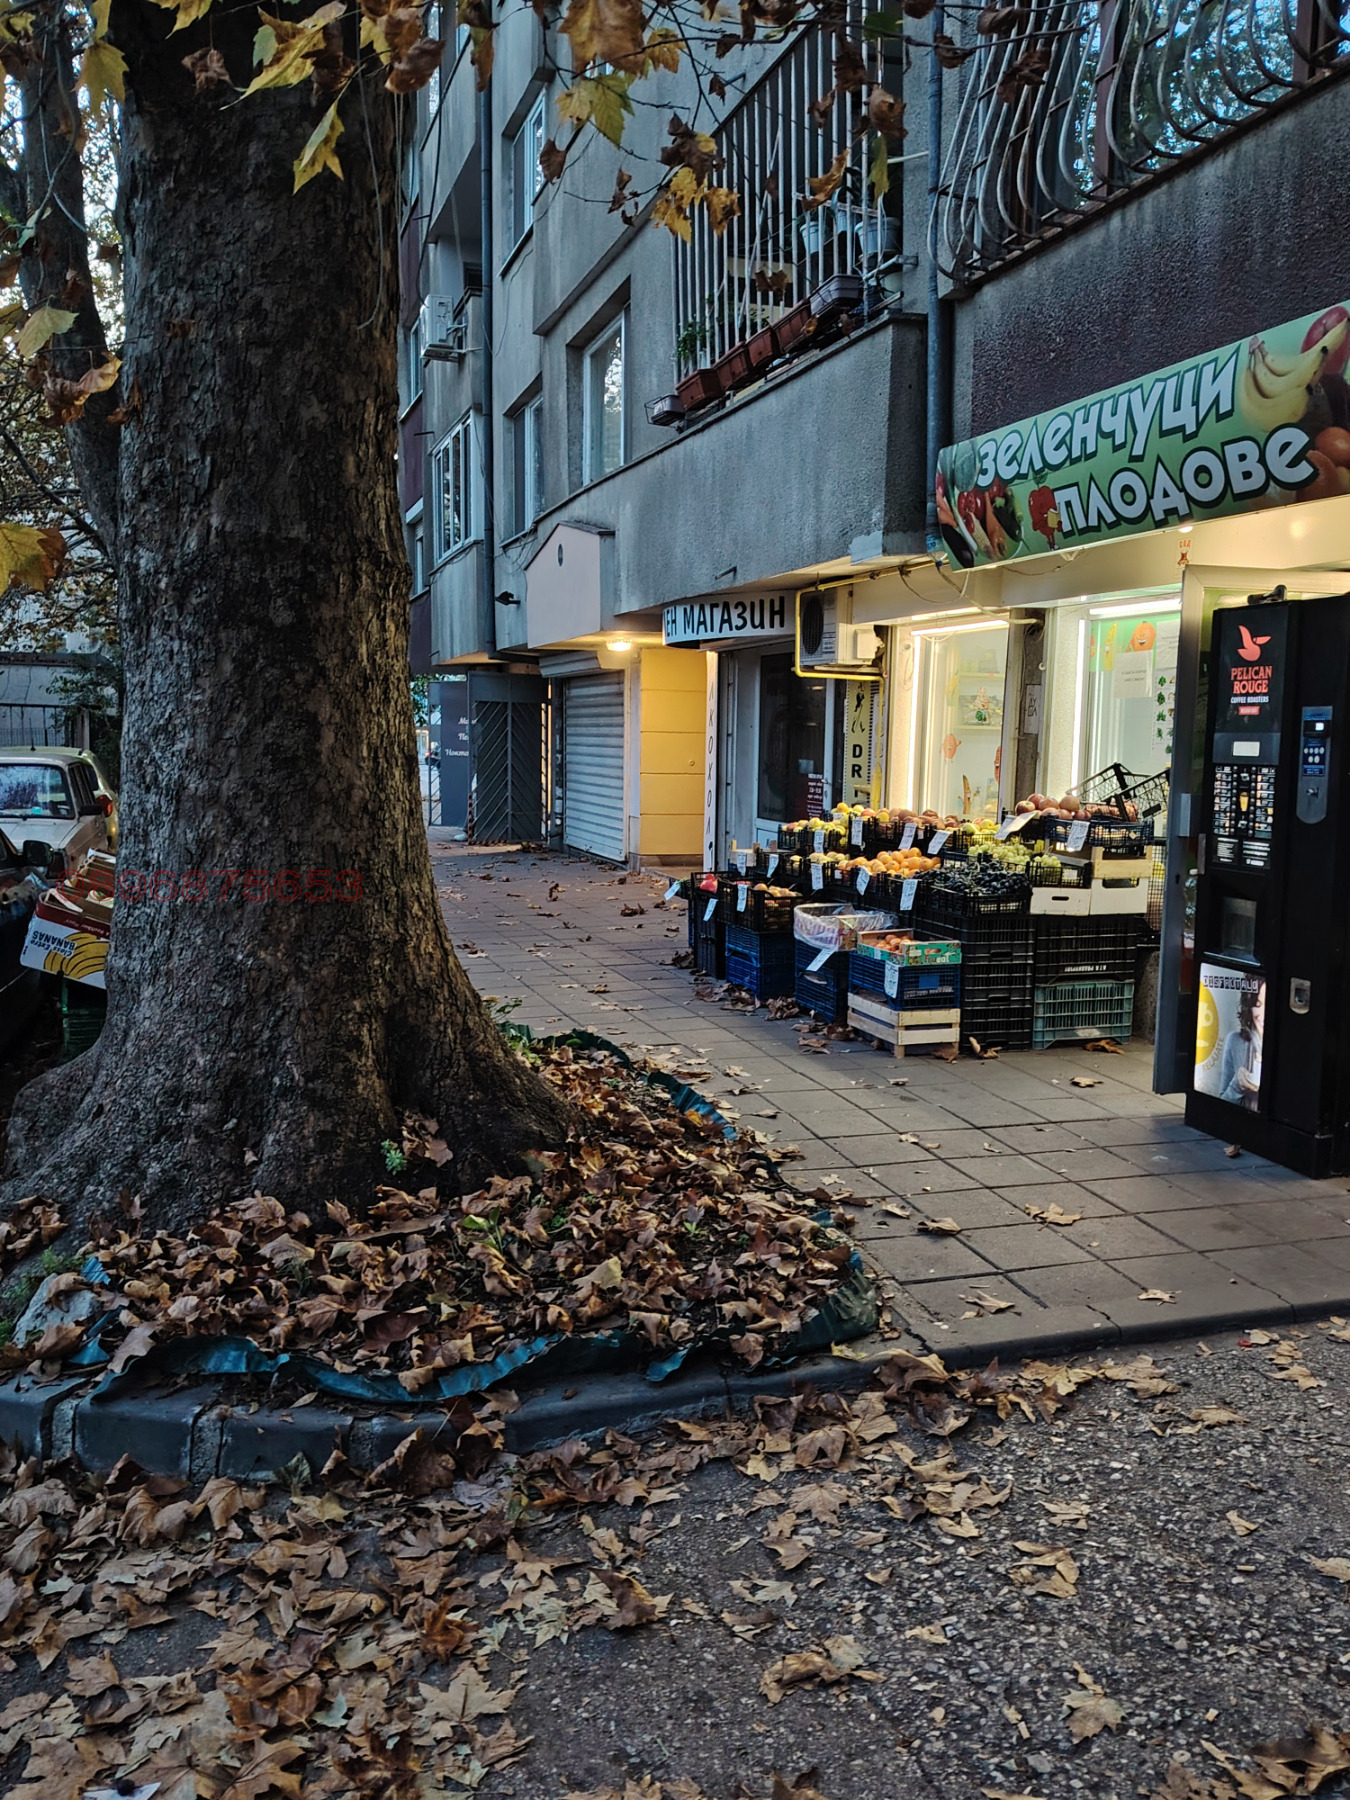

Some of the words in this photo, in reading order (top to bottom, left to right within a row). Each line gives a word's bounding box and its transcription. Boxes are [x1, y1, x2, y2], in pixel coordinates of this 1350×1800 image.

[1231, 666, 1272, 680] PELICAN
[1233, 680, 1269, 694] ROUGE
[30, 939, 51, 951] Extra
[32, 930, 76, 951] BANANAS
[52, 946, 73, 957] Class
